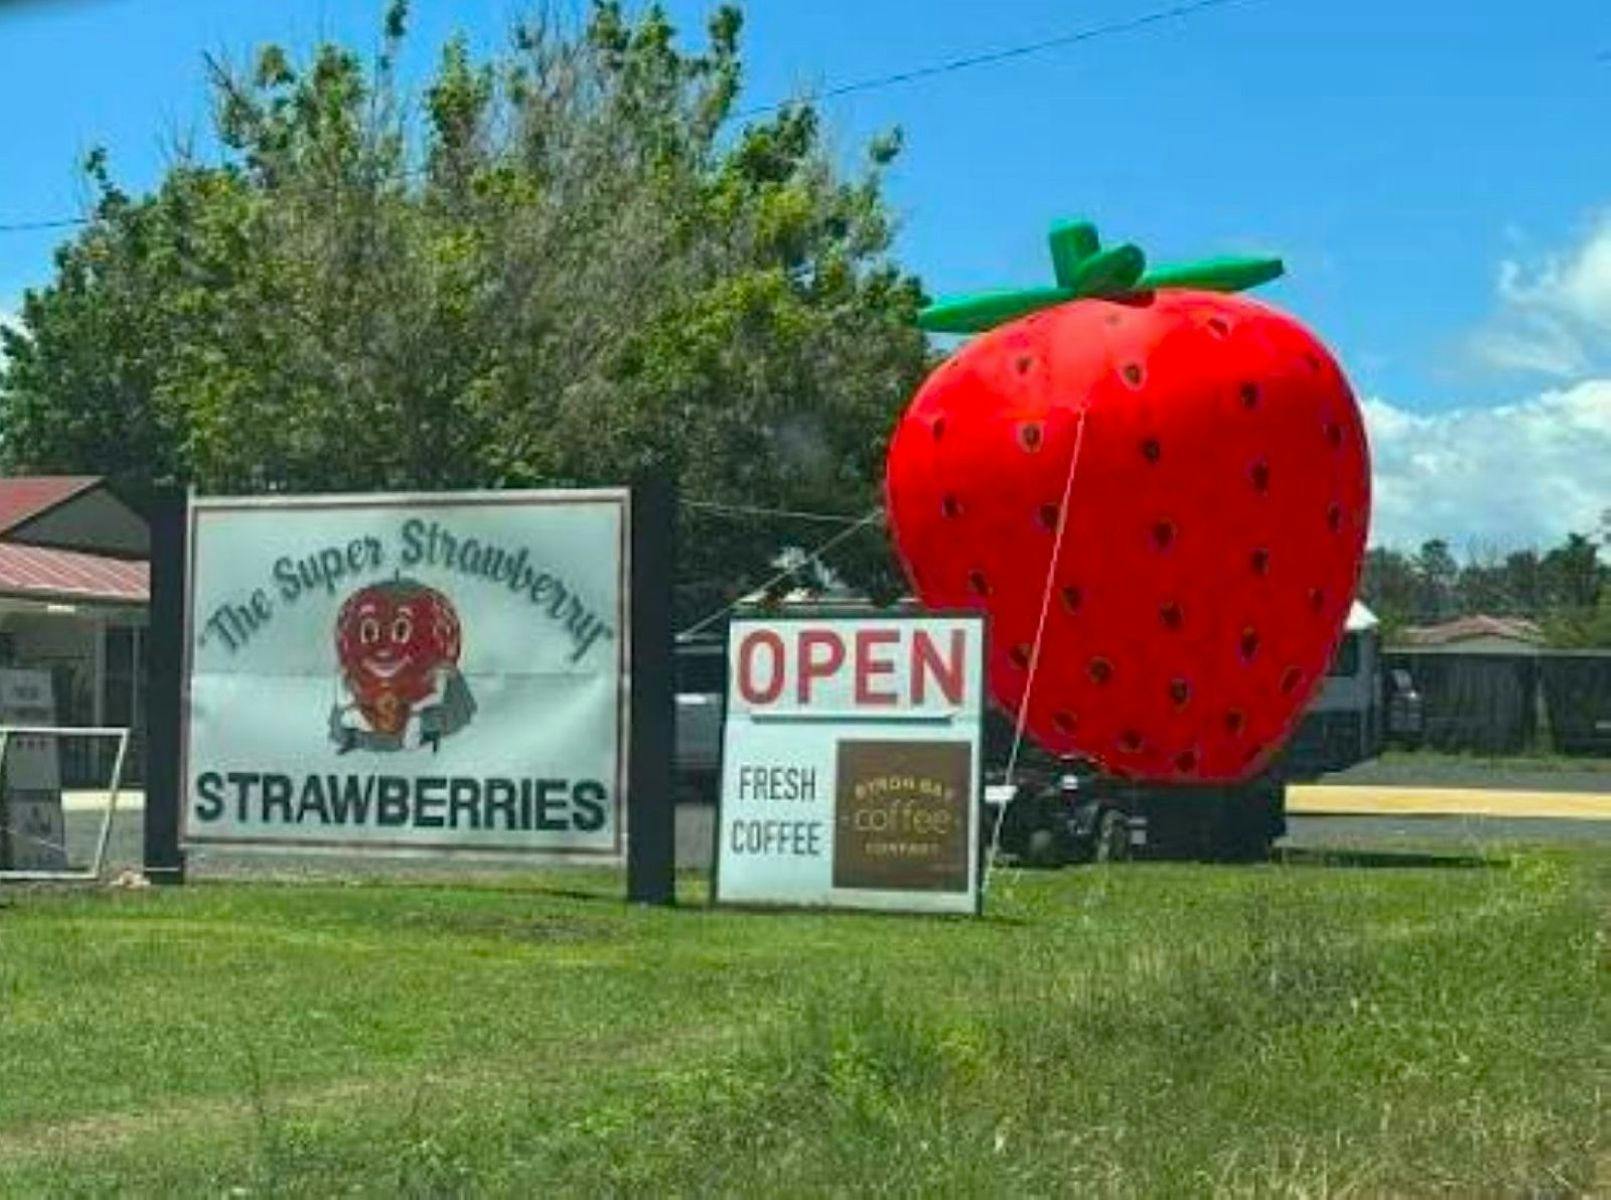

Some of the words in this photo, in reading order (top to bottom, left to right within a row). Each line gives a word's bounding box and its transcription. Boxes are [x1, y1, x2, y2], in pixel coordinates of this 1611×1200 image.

[273, 534, 382, 602] Super
[738, 628, 966, 706] OPEN
[195, 772, 608, 831] STRAWBERRIES
[739, 766, 816, 801] FRESH
[732, 820, 822, 856] COFFEE
[855, 798, 951, 834] coffee
